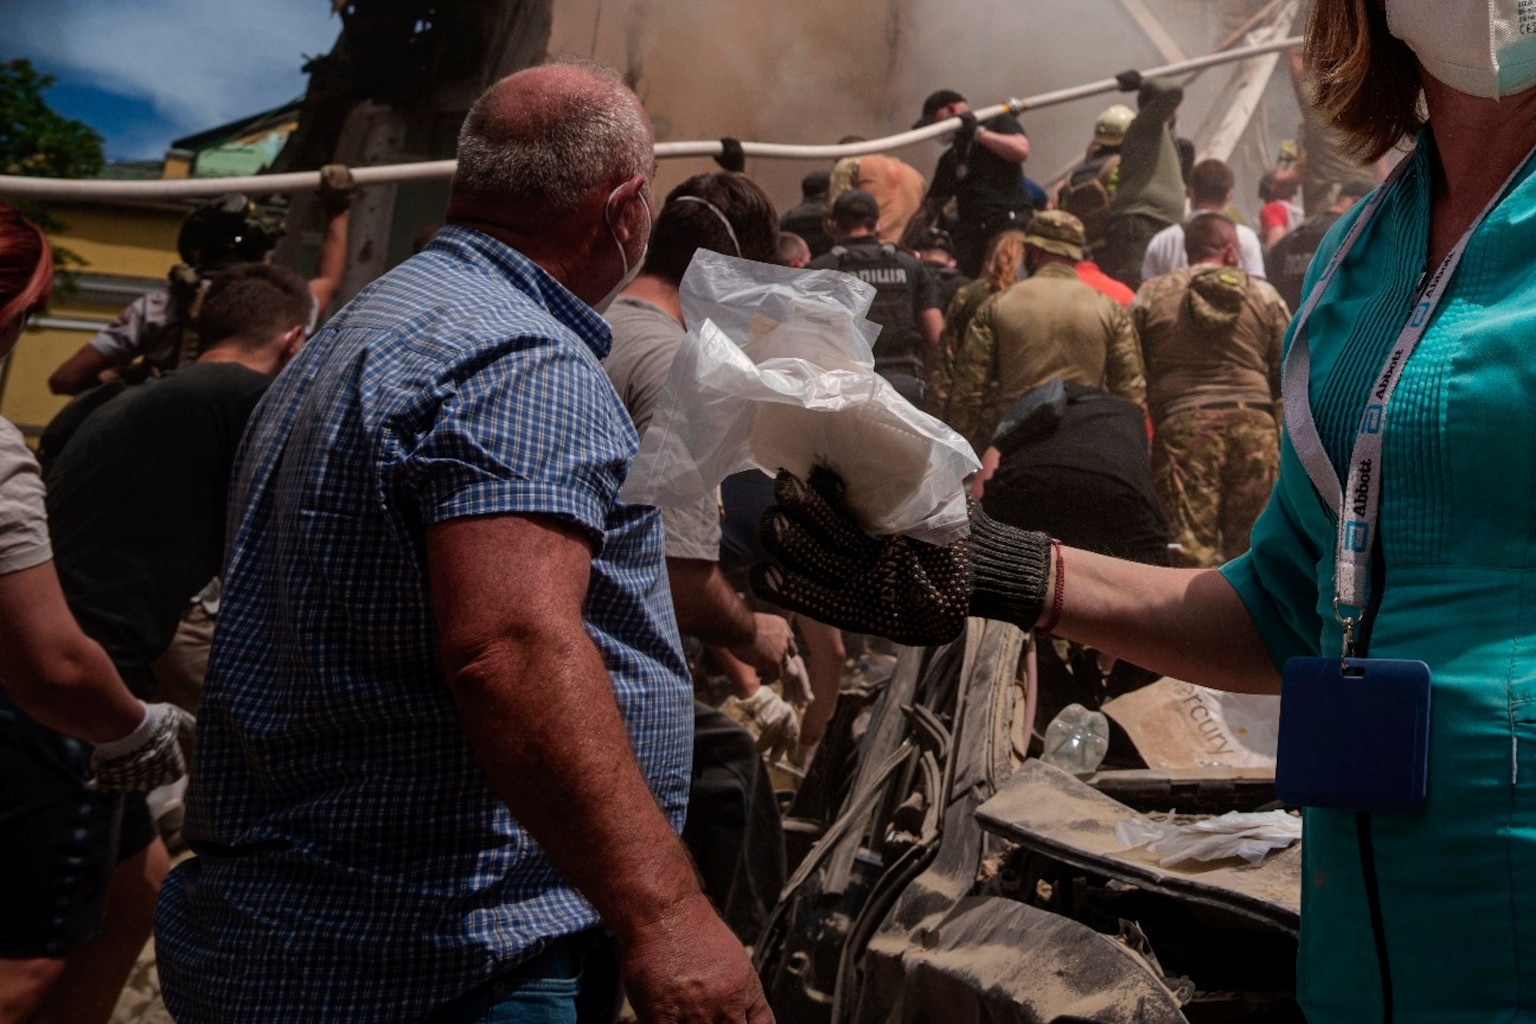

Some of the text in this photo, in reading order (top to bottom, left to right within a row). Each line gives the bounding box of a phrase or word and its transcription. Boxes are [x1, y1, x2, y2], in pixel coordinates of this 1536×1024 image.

[848, 268, 907, 284] ЛІЦІЯ
[1426, 251, 1456, 298] Abbott
[1375, 348, 1404, 401] Abbott
[1353, 458, 1372, 518] Abbott
